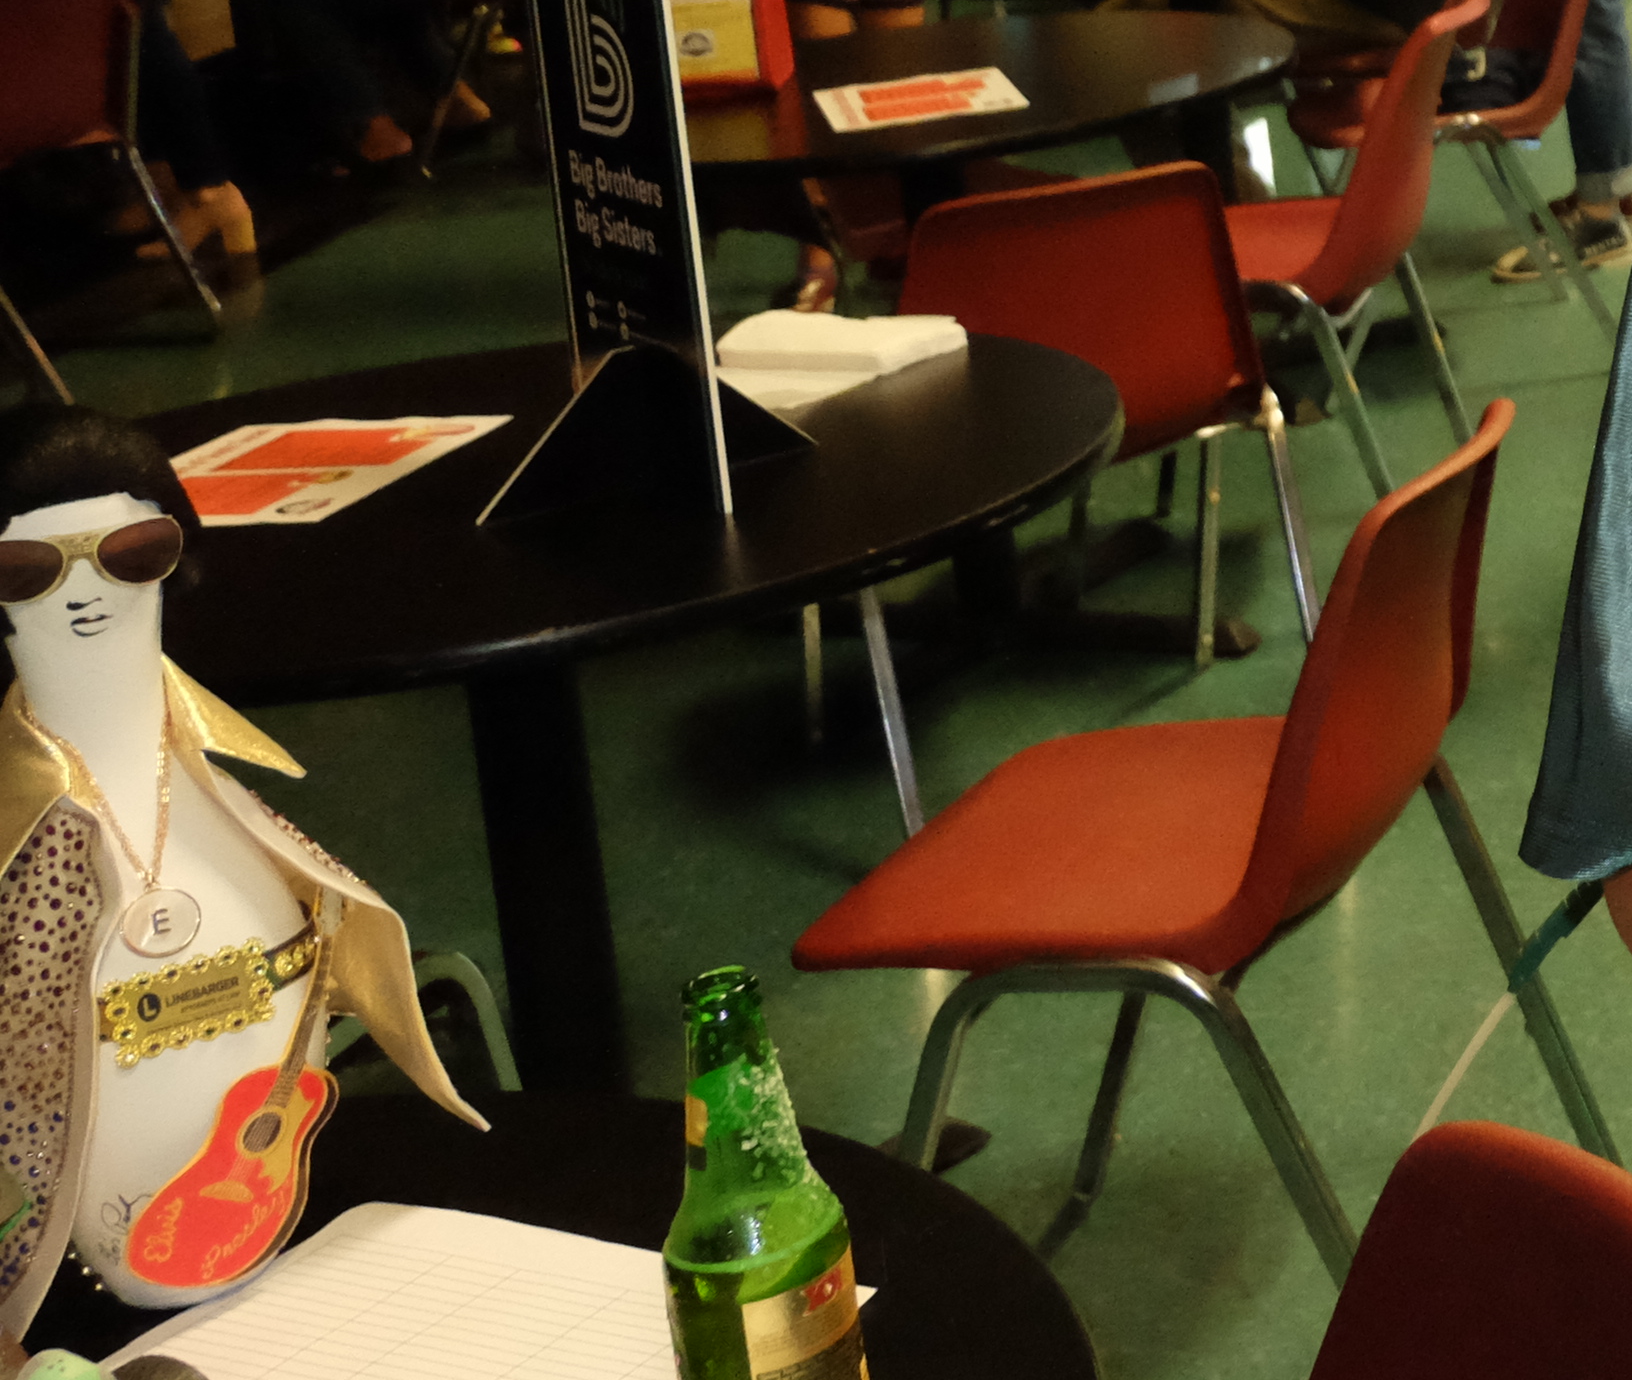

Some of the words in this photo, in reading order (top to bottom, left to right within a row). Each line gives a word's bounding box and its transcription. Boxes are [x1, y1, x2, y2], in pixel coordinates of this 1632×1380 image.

[568, 149, 596, 199] Big
[595, 156, 663, 208] Brothers
[575, 198, 602, 249] Big
[601, 206, 656, 255] Sisters
[151, 908, 172, 935] E
